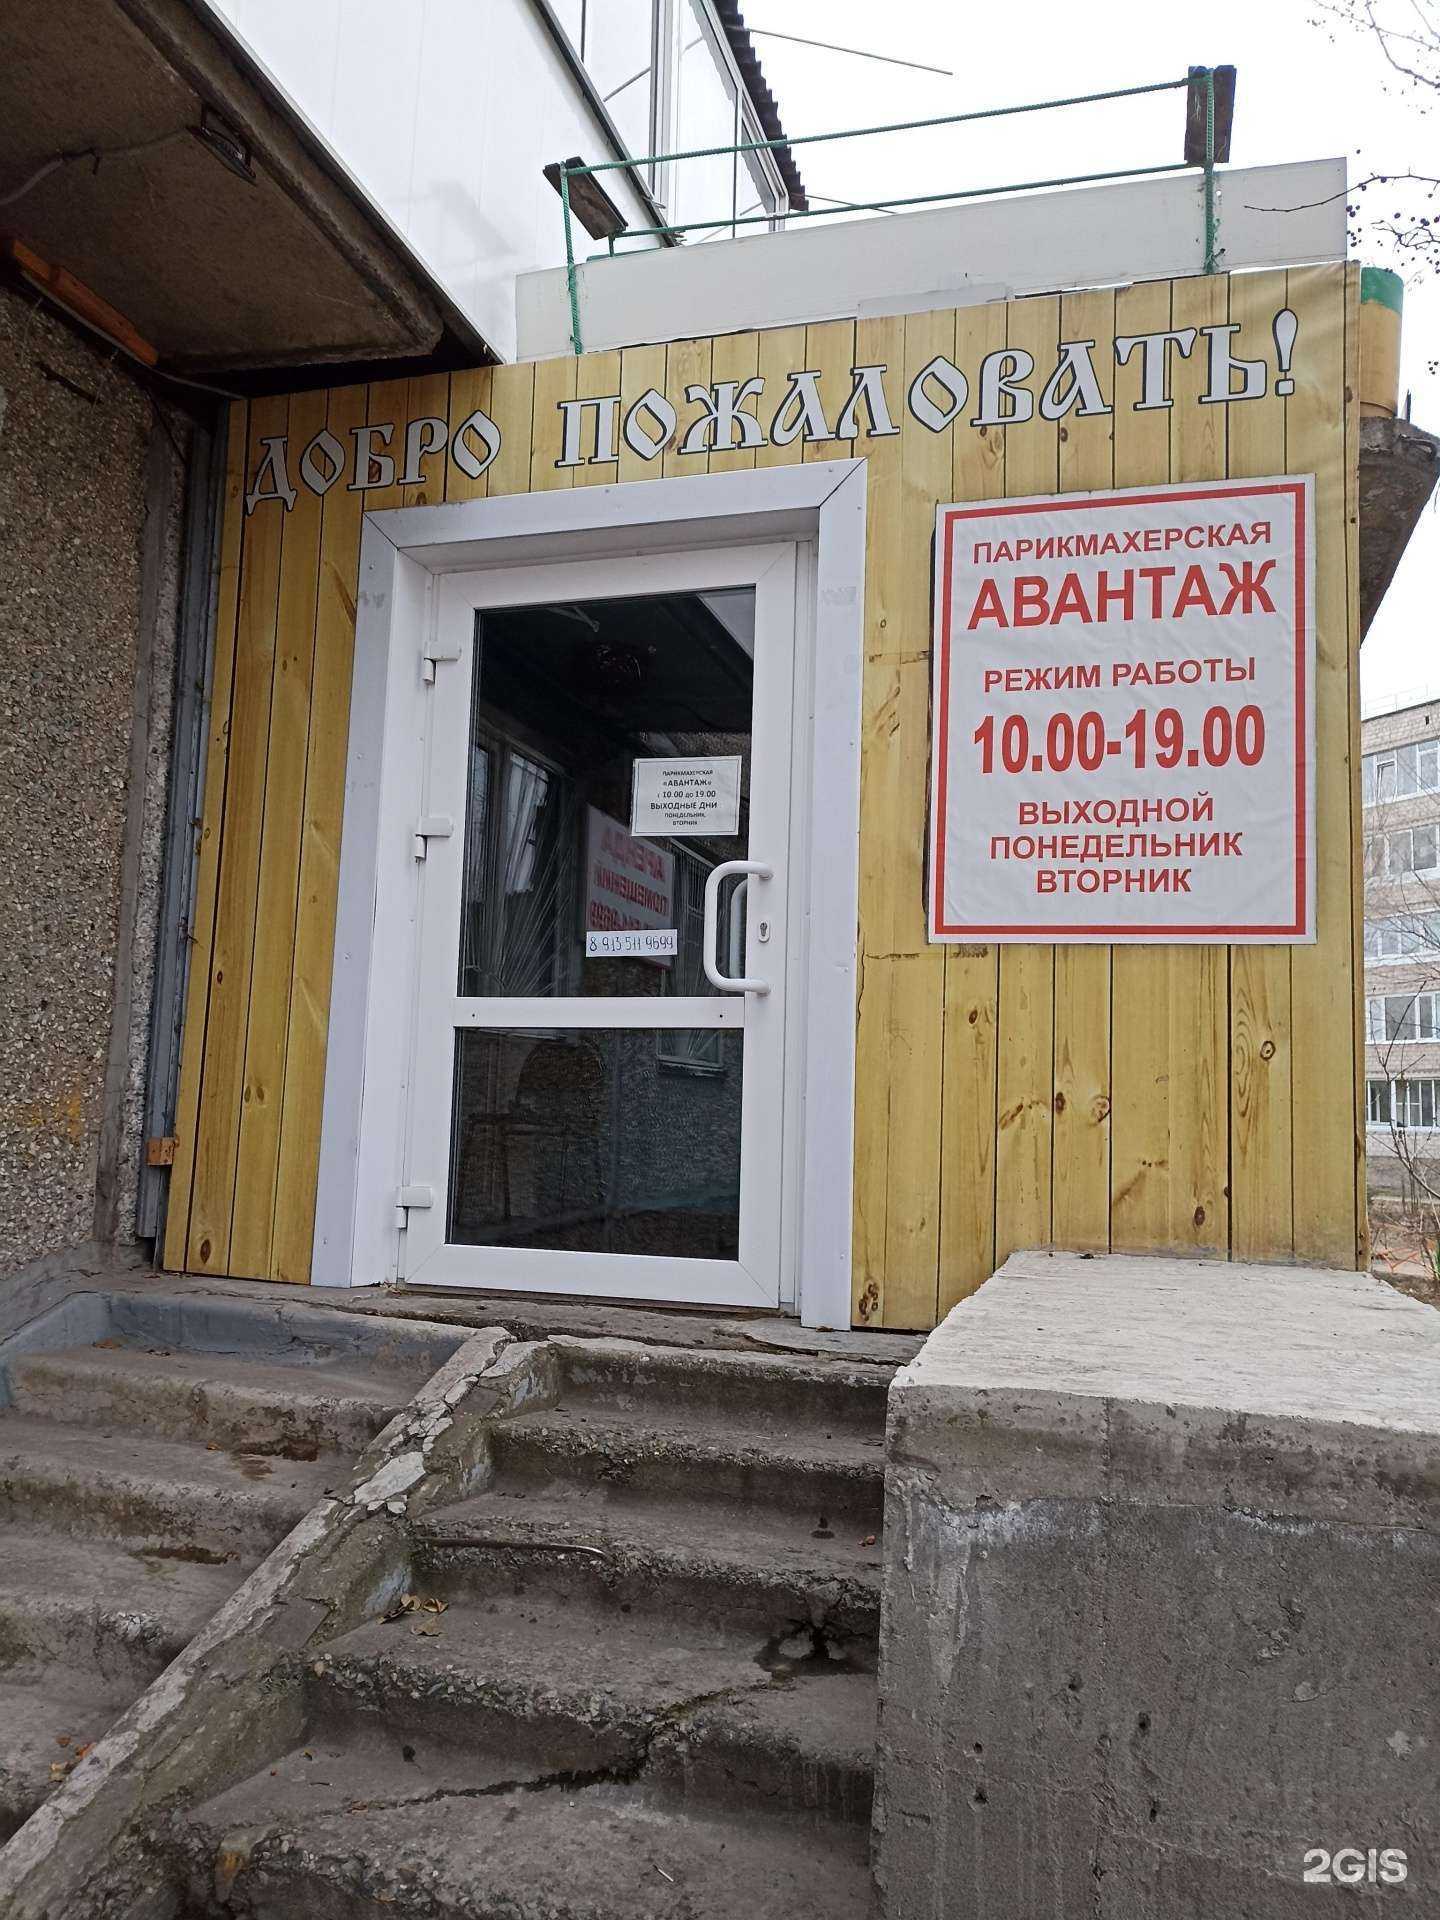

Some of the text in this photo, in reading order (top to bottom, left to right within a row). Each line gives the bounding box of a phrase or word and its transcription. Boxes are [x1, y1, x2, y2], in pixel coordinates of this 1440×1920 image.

[246, 308, 1299, 516] ДОБРО ПОЖАЛОВАТЬ!
[972, 521, 1272, 564] ПАРИКМАХЕРСКАЯ
[967, 559, 1277, 631] АВАНТАЖ
[984, 657, 1256, 693] РЕЖИМ РАБОТЫ
[973, 704, 1266, 775] 10.00-19.00
[650, 801, 718, 811] ВЫХОДНЫЕ ДНИ
[662, 790, 684, 798] 10.00
[695, 790, 717, 798] 19.00
[1018, 791, 1214, 828] ВЫХОДНОЙ
[989, 833, 1243, 862] ПОНЕДЕЛЬНИК
[1036, 869, 1192, 895] ВТОРНИК
[589, 936, 598, 952] 8
